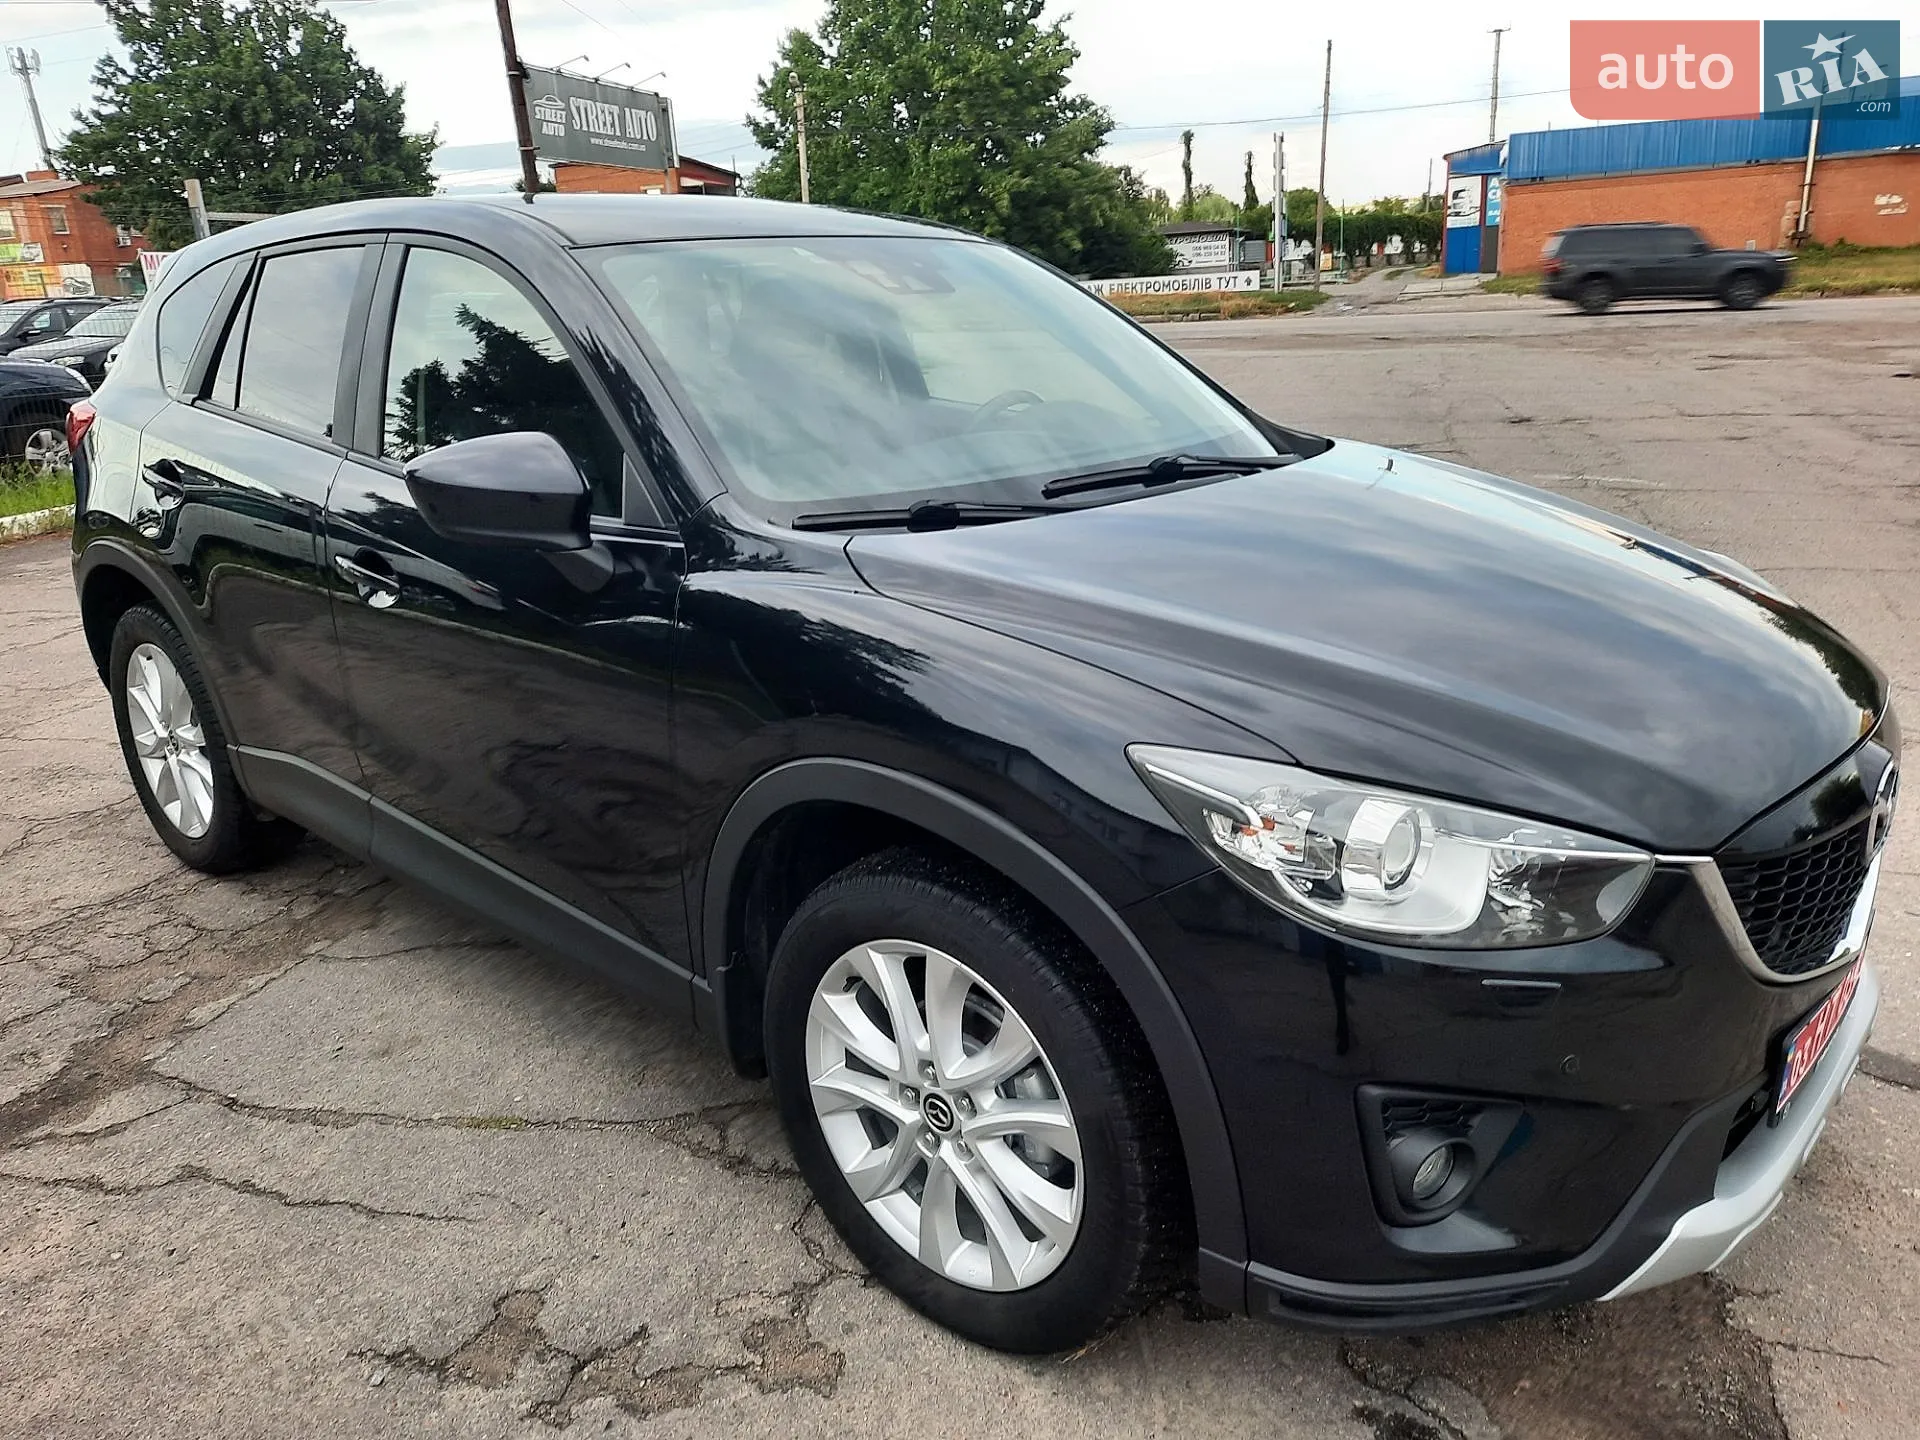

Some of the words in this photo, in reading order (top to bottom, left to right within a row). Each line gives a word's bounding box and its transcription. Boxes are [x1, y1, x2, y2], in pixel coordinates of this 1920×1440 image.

[534, 106, 567, 123] STREET
[569, 96, 622, 136] STREET
[623, 107, 657, 142] AUTO
[541, 121, 566, 137] AUTO
[1216, 276, 1238, 289] ТУТ
